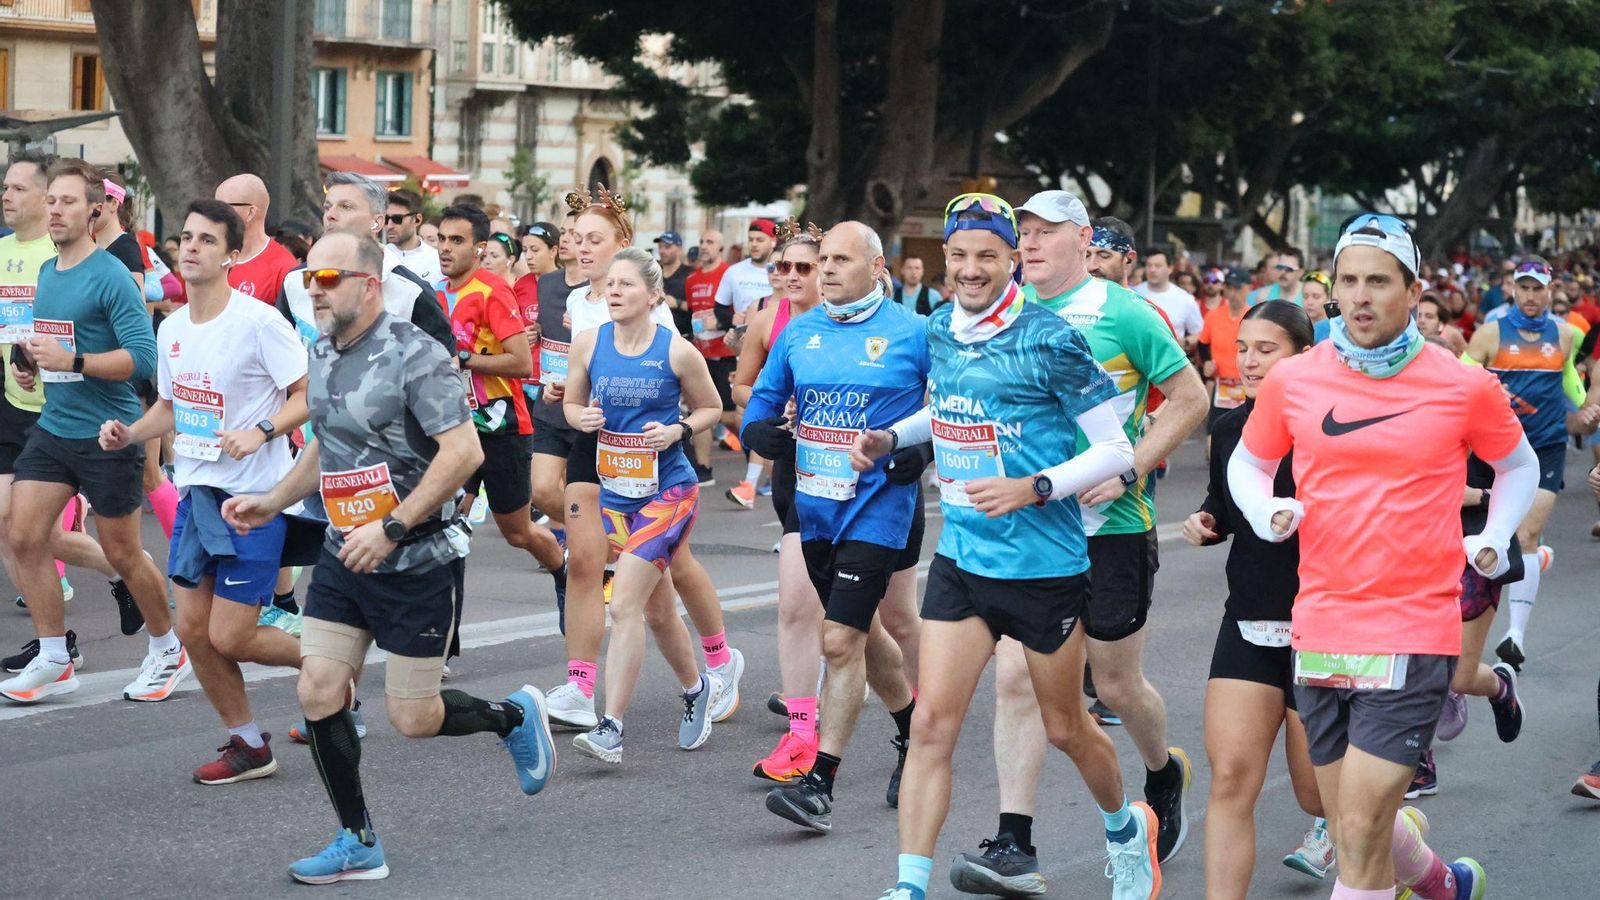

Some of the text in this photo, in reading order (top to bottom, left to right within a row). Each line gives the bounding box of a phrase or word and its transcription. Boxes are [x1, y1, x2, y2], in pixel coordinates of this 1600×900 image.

[40, 323, 69, 334] GENERALI
[610, 376, 664, 389] BENTLEY
[179, 386, 219, 405] GENERALI
[606, 387, 659, 399] RUNNING
[804, 388, 870, 408] ORO DE
[610, 397, 642, 407] CLUB
[939, 394, 985, 417] MEDIA
[175, 408, 208, 427] 17803
[807, 430, 854, 443] GENERALI
[940, 425, 989, 440] GENERALI
[608, 436, 649, 447] GENERAL
[606, 454, 642, 470] 14380
[804, 450, 841, 468] 12766
[940, 451, 980, 470] 16007
[332, 470, 382, 488] GENERALI
[336, 497, 375, 516] 7420
